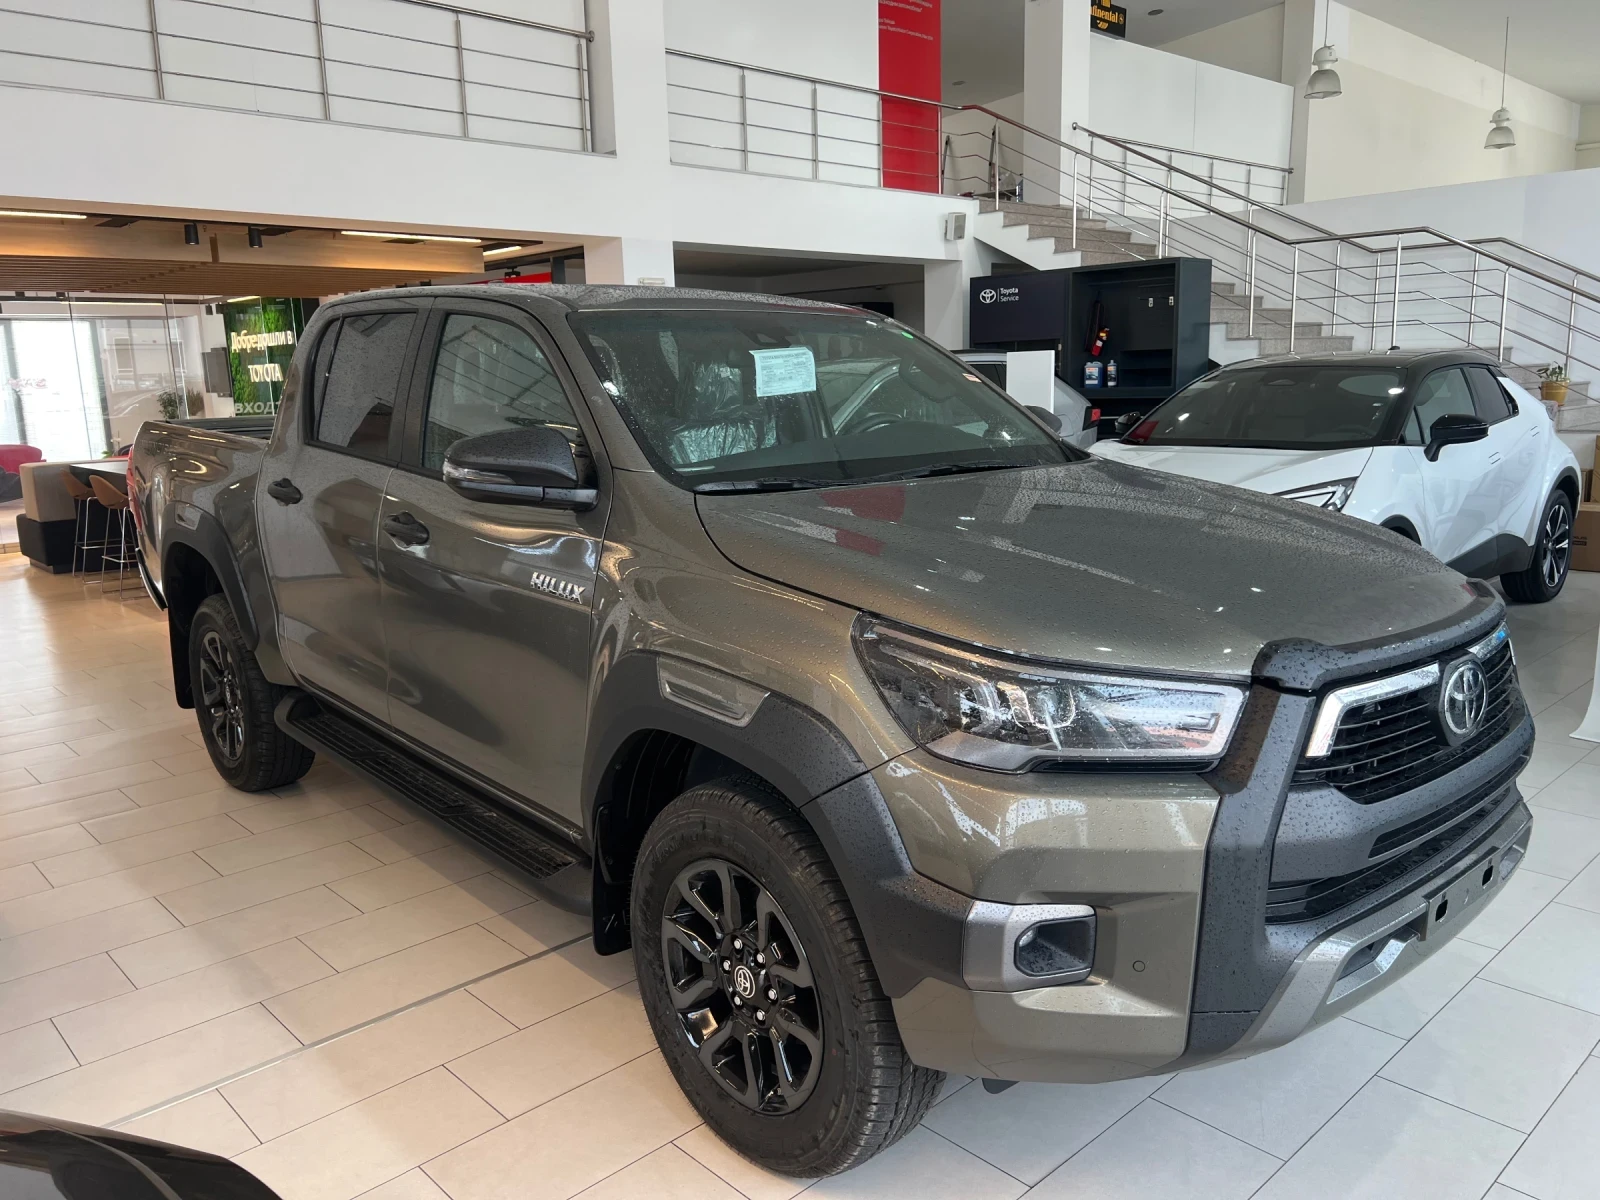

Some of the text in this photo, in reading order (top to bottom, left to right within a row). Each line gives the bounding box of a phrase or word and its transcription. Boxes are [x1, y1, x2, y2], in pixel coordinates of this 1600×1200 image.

[1000, 287, 1019, 295] Toyota
[231, 330, 286, 353] Добредошли
[248, 363, 284, 383] TOYOTA
[530, 571, 586, 605] HILUX
